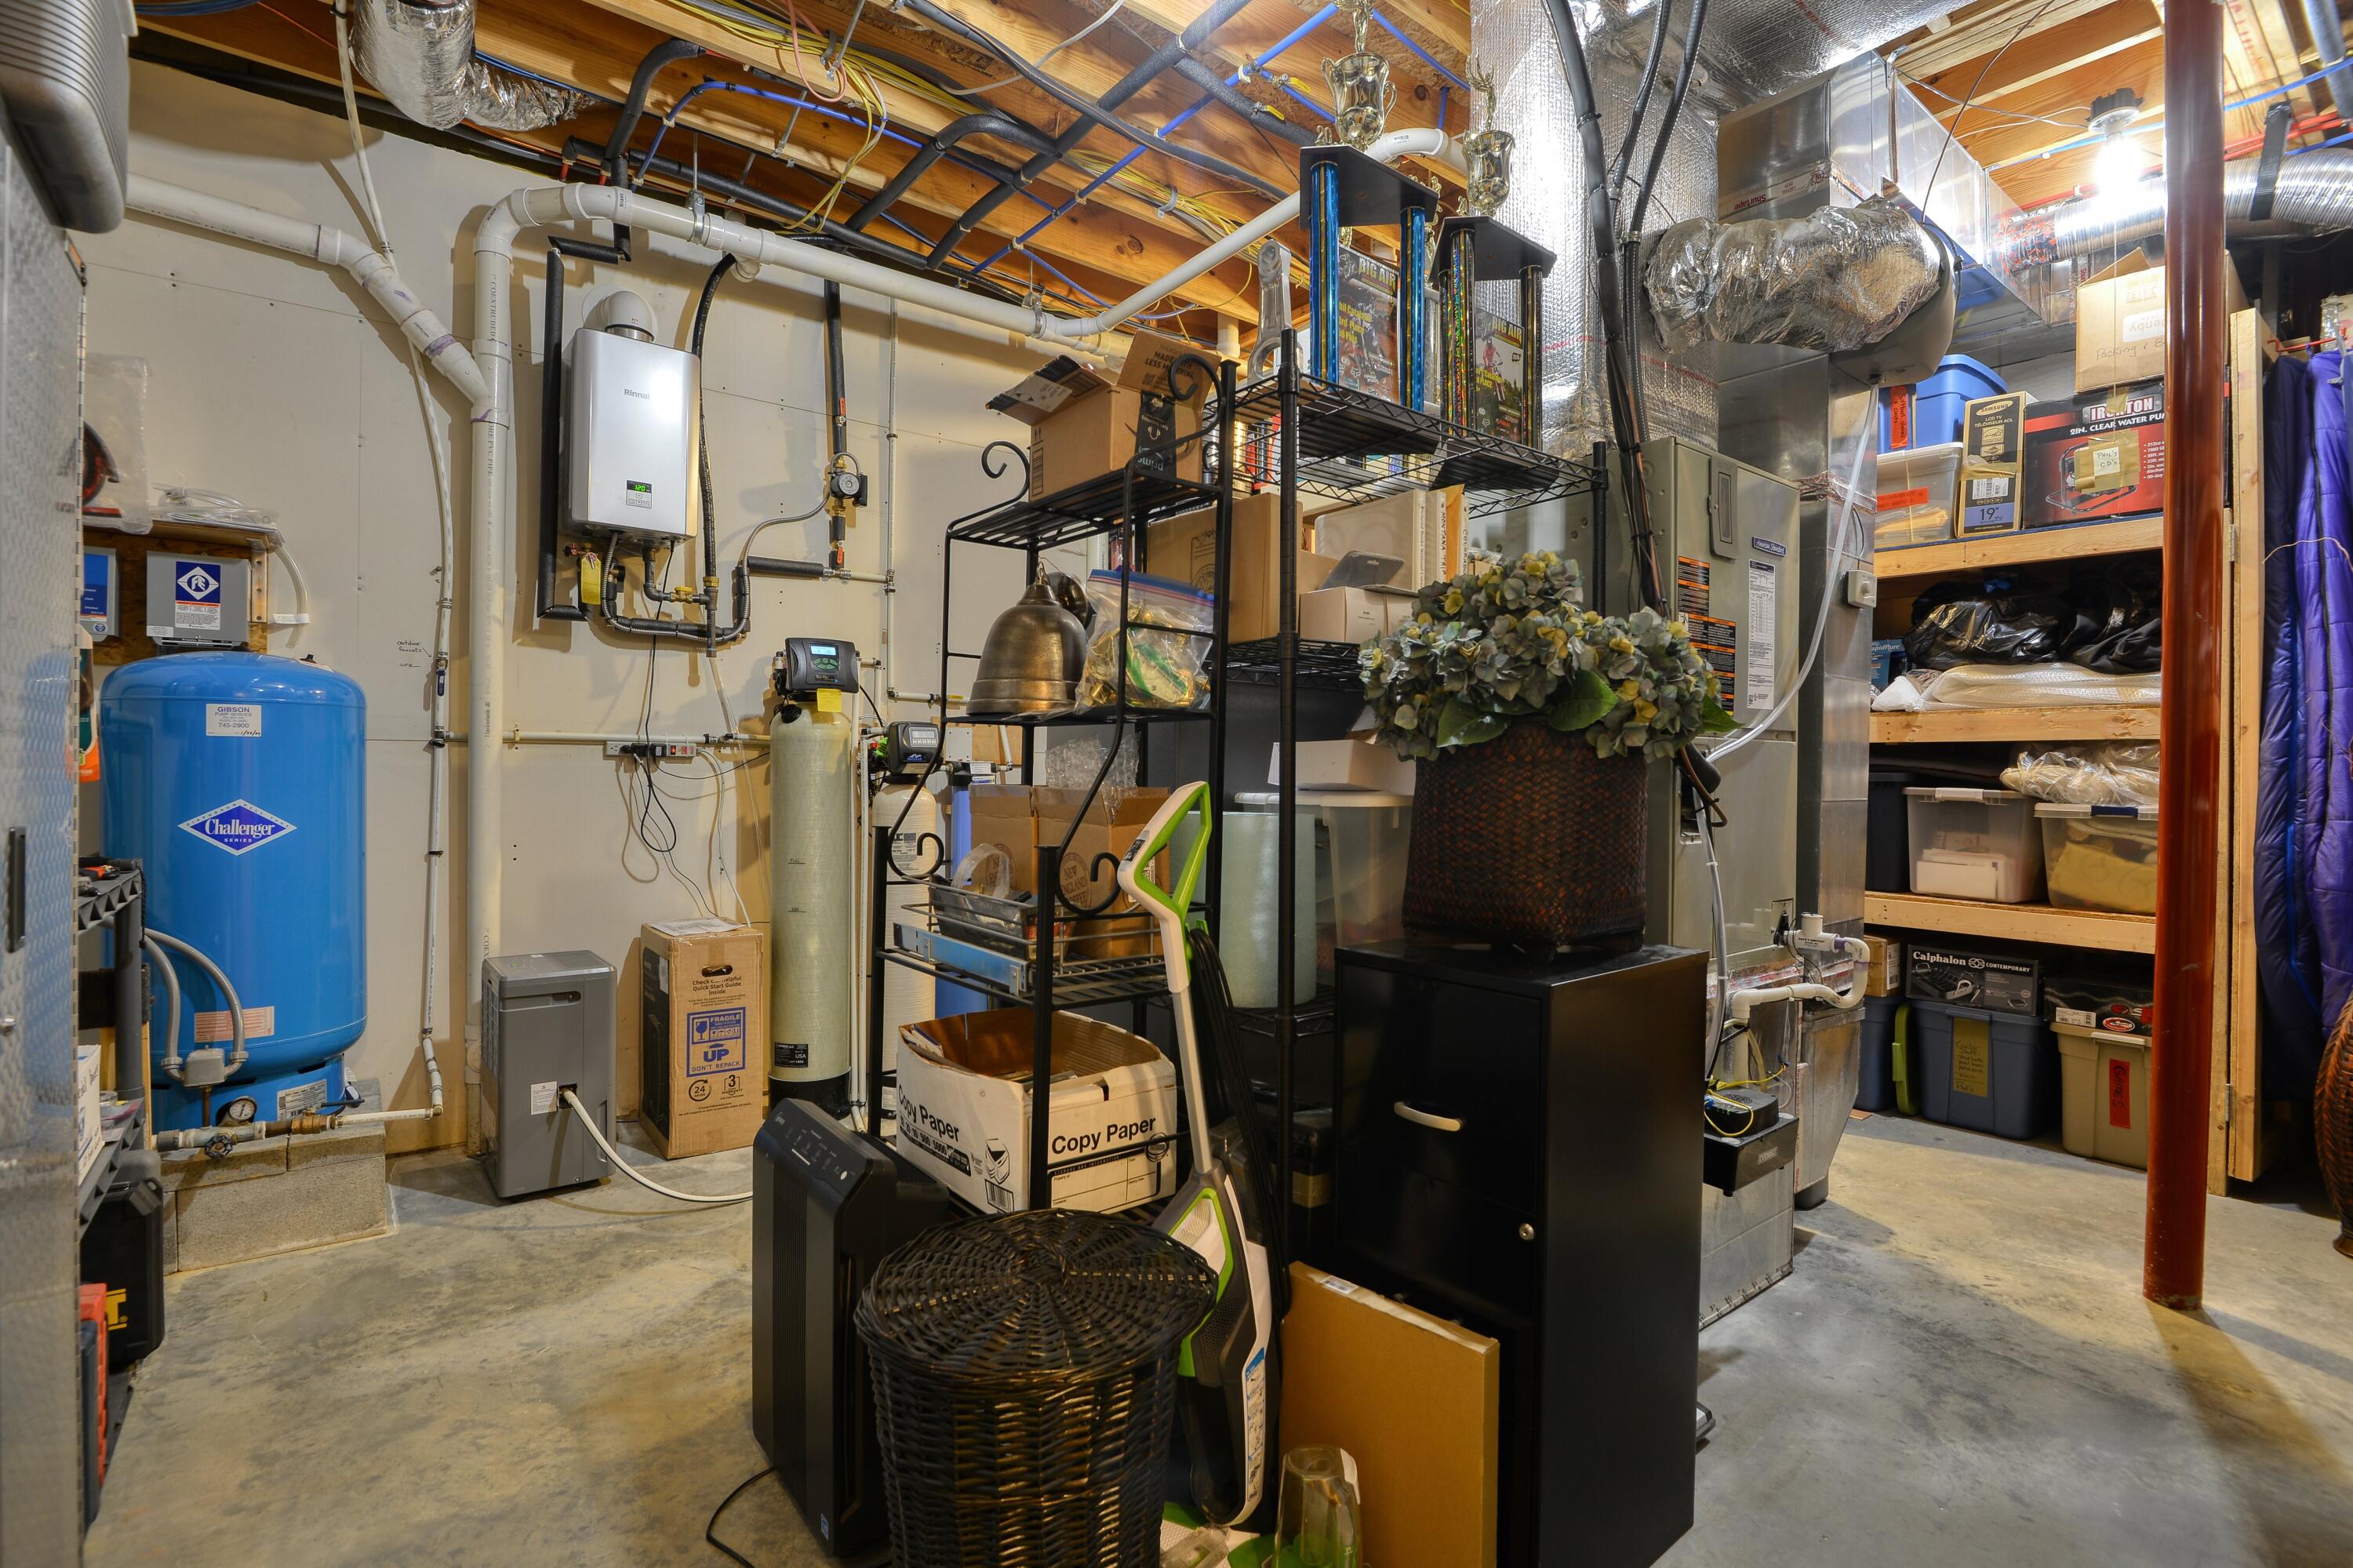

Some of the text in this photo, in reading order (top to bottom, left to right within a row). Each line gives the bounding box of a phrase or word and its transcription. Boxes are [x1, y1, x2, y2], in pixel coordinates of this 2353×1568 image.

[1358, 256, 1377, 278] BIG
[1493, 315, 1522, 344] BIG AIR
[1154, 351, 1174, 363] MADE
[2097, 345, 2137, 362] Packing
[1145, 358, 1194, 378] LESS MERIAL
[624, 388, 650, 400] Rinnai
[2070, 413, 2165, 435] 2IN. CLEAR WATER PU
[205, 819, 275, 839] Challenger
[1064, 865, 1077, 879] NEW
[1913, 951, 1966, 966] Calphalon
[1986, 962, 2030, 973] CONTEMPORARY
[704, 1048, 729, 1062] UP
[715, 1060, 740, 1069] REPACK
[728, 1075, 736, 1087] 3
[694, 1086, 705, 1094] 24
[899, 1084, 959, 1142] Copy Paper
[1052, 1118, 1156, 1155] Copy Paper
